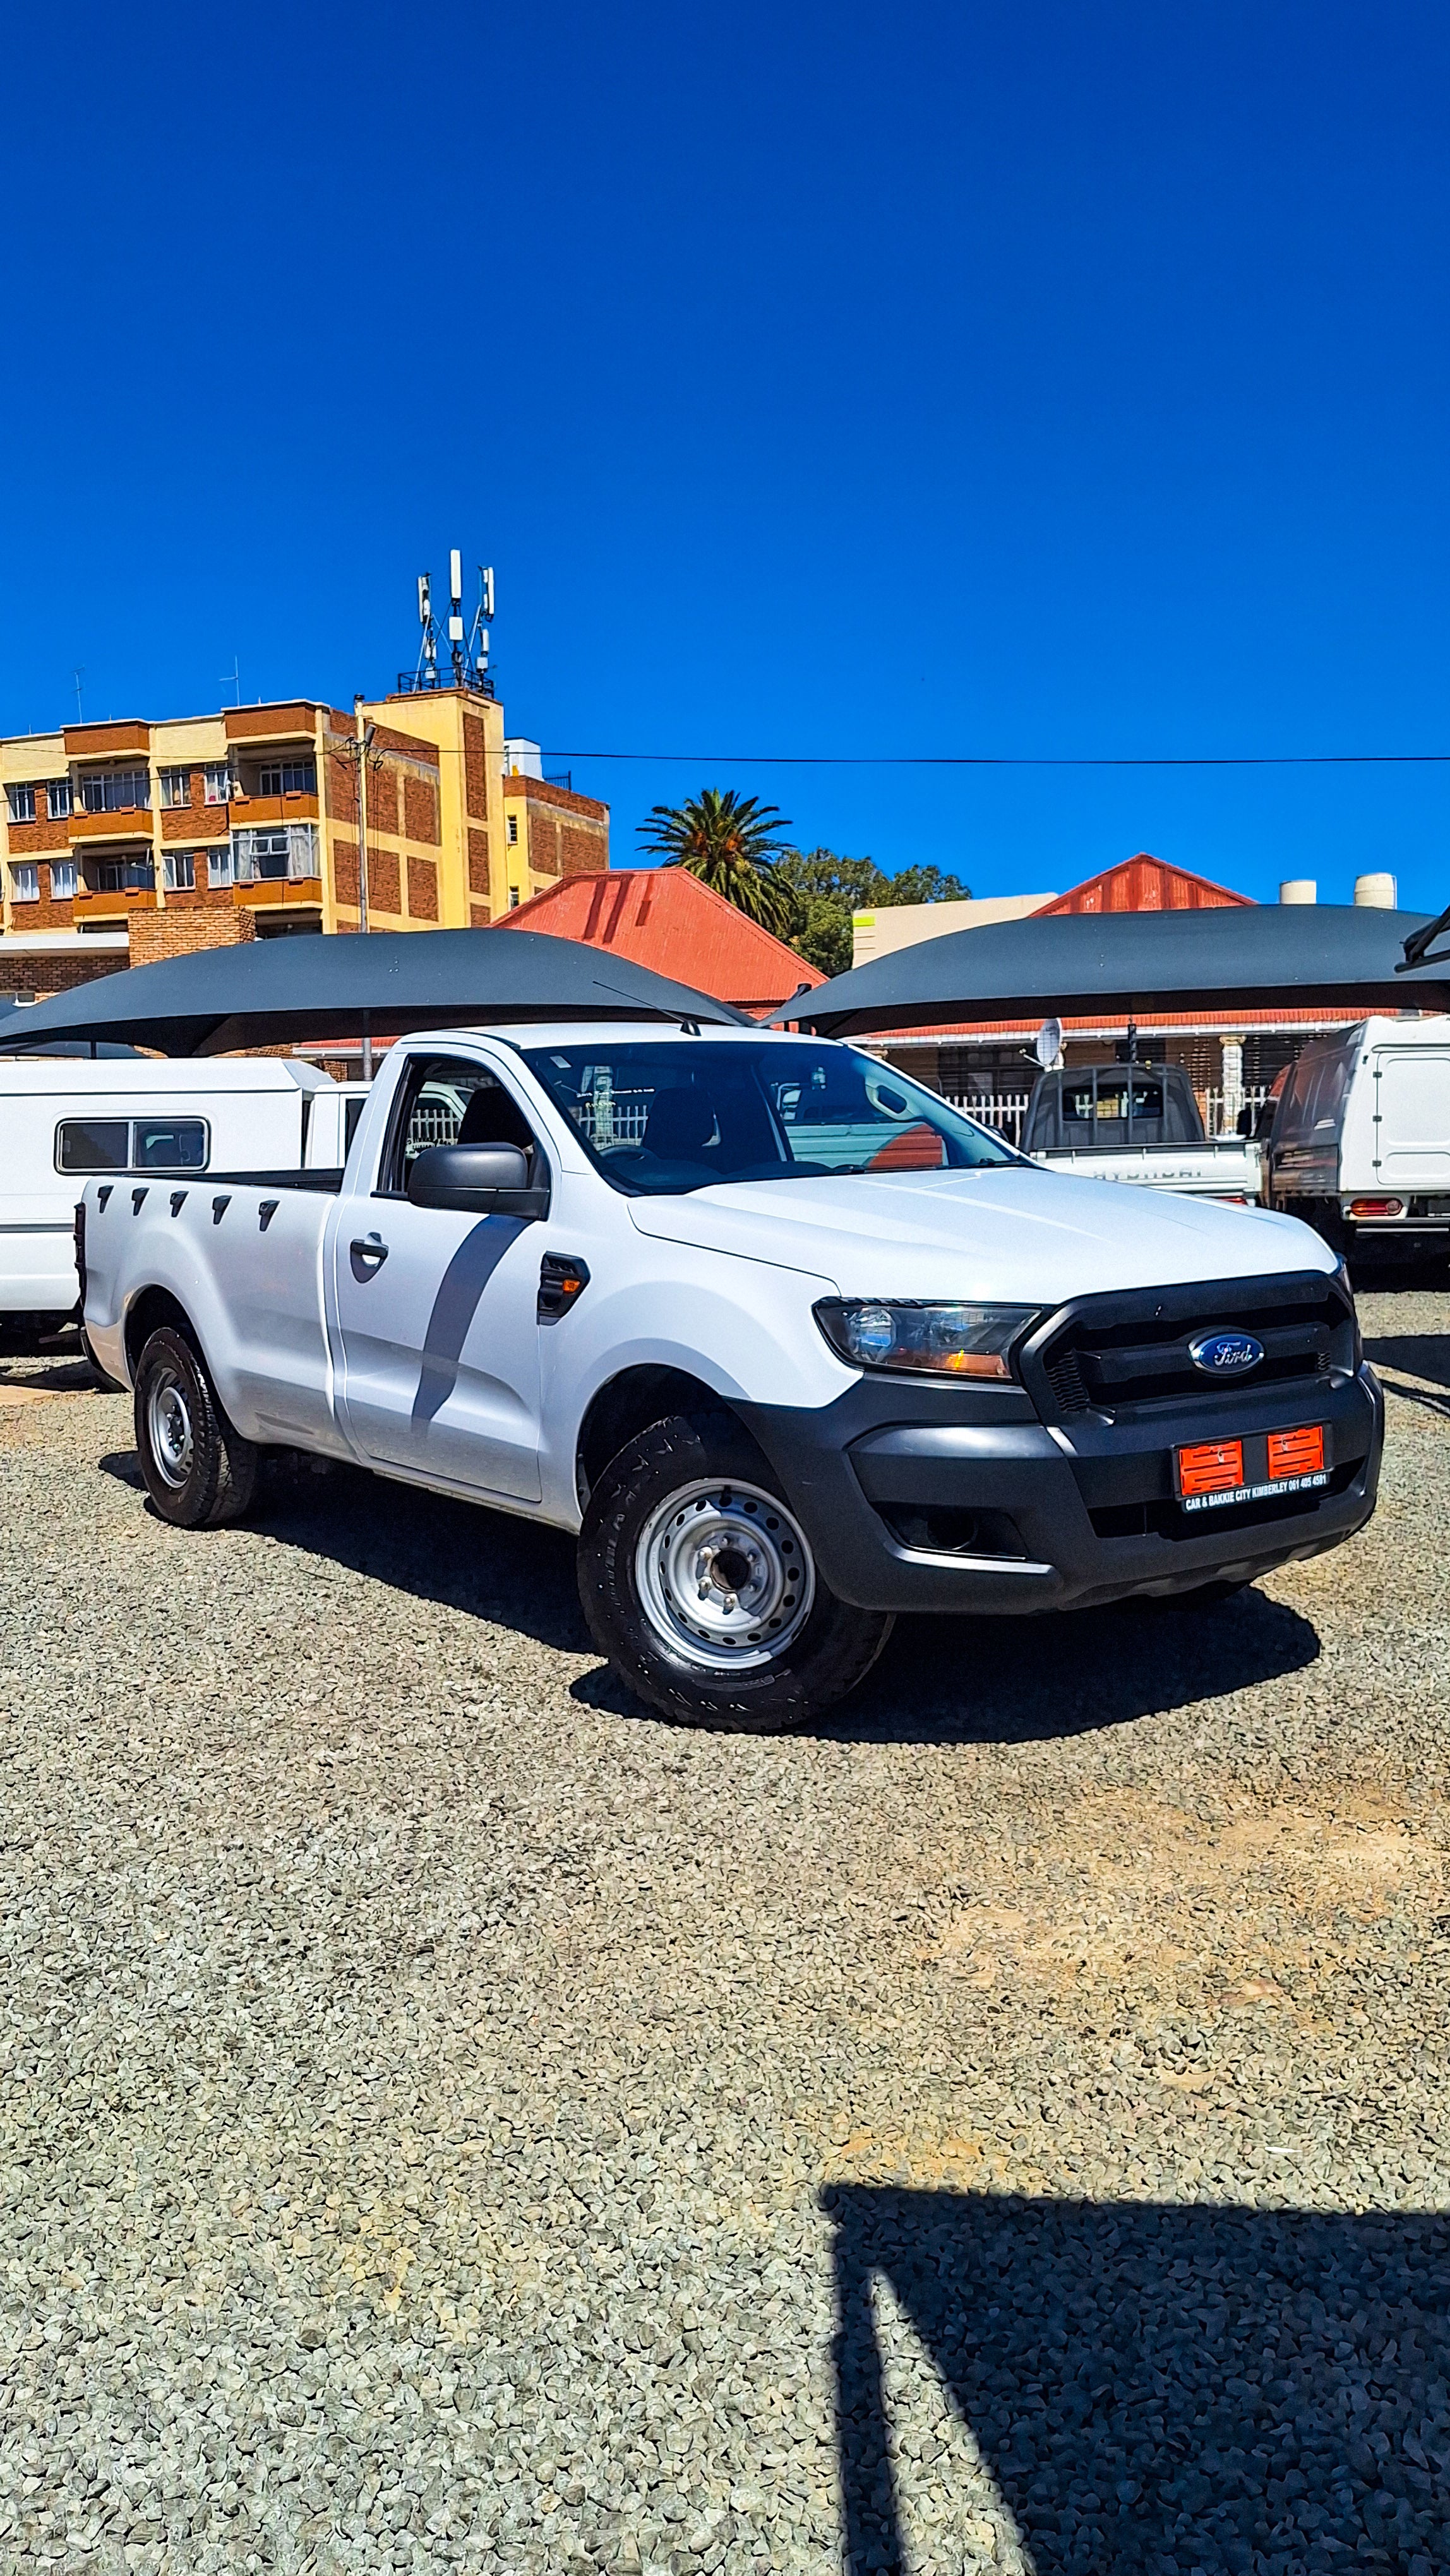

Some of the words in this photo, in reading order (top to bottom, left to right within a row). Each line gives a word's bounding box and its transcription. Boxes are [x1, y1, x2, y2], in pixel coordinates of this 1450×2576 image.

[1214, 1341, 1252, 1366] Ford
[1185, 1497, 1201, 1510] CAR
[1202, 1496, 1208, 1508] &
[1209, 1491, 1235, 1506] BAKKIE
[1235, 1488, 1251, 1502] CITY
[1252, 1481, 1288, 1498] KIMBERLEY
